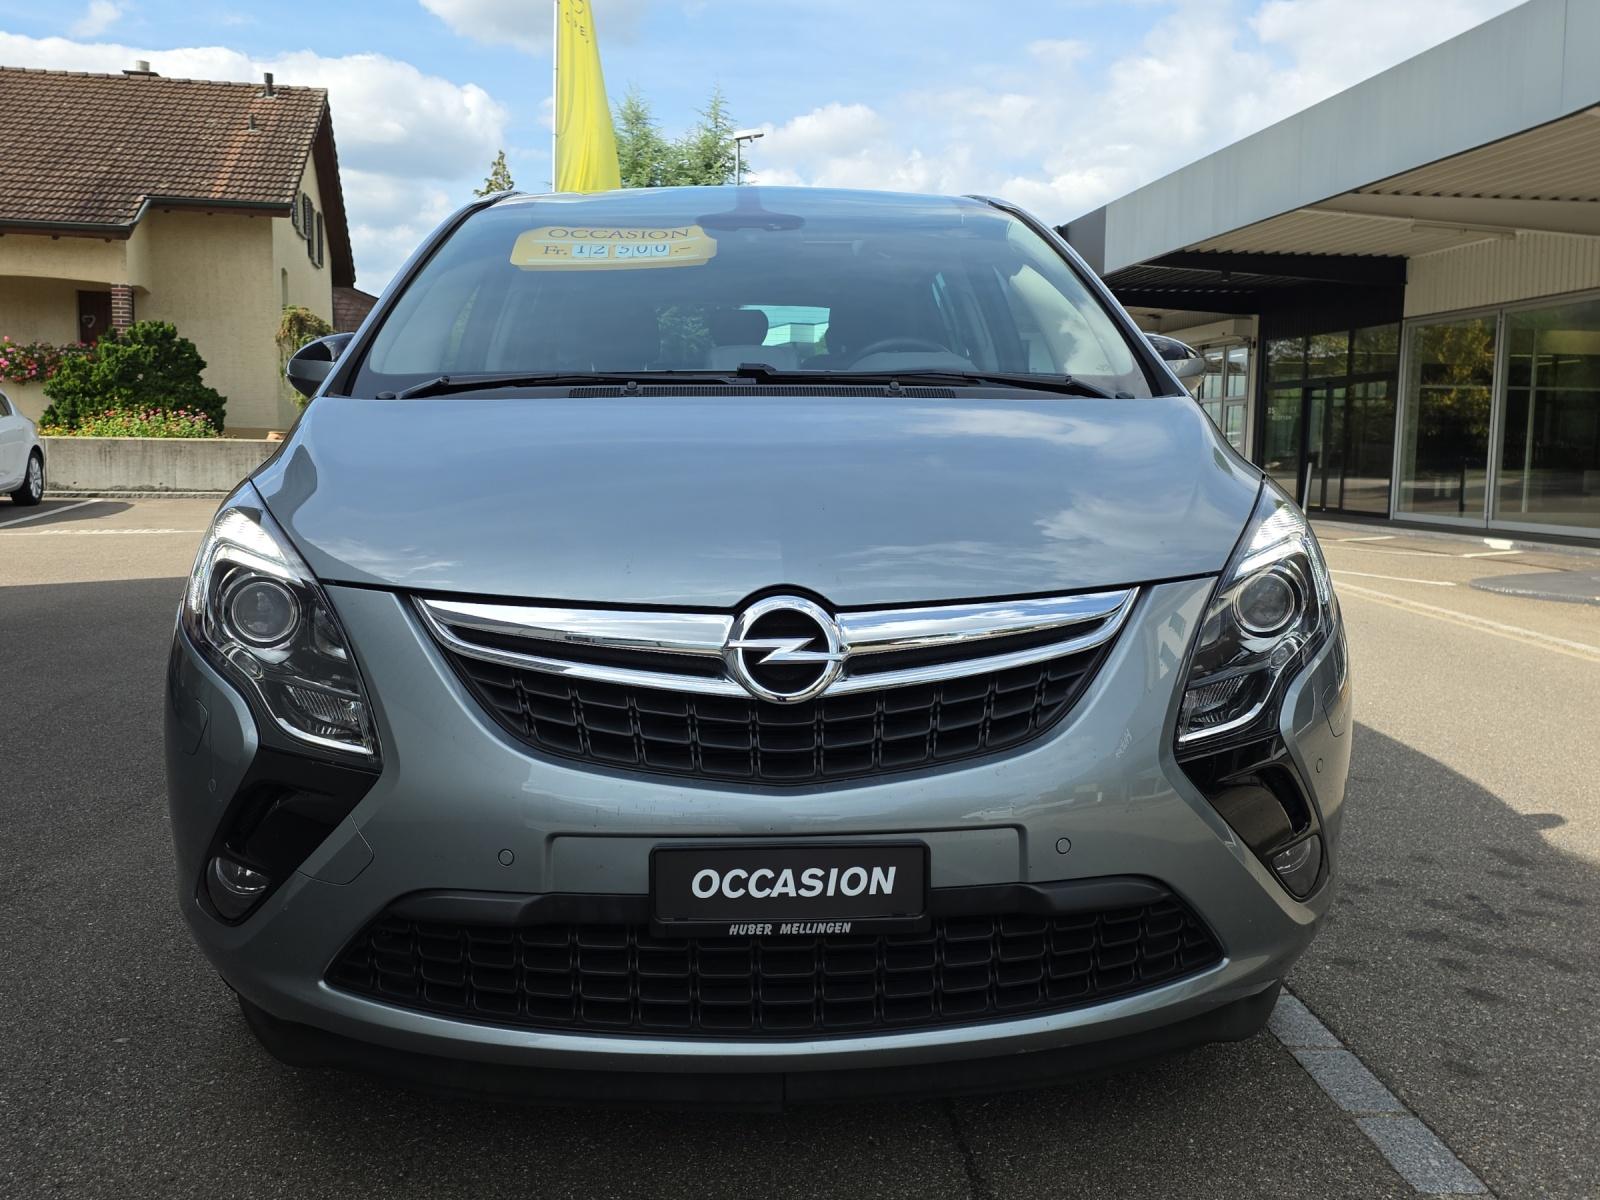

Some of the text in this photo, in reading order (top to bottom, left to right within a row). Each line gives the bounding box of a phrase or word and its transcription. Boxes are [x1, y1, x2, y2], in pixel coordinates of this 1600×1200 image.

[548, 229, 689, 240] OCCASION
[691, 866, 897, 899] OCCASION
[729, 922, 852, 935] HUBER MELLINGEN
